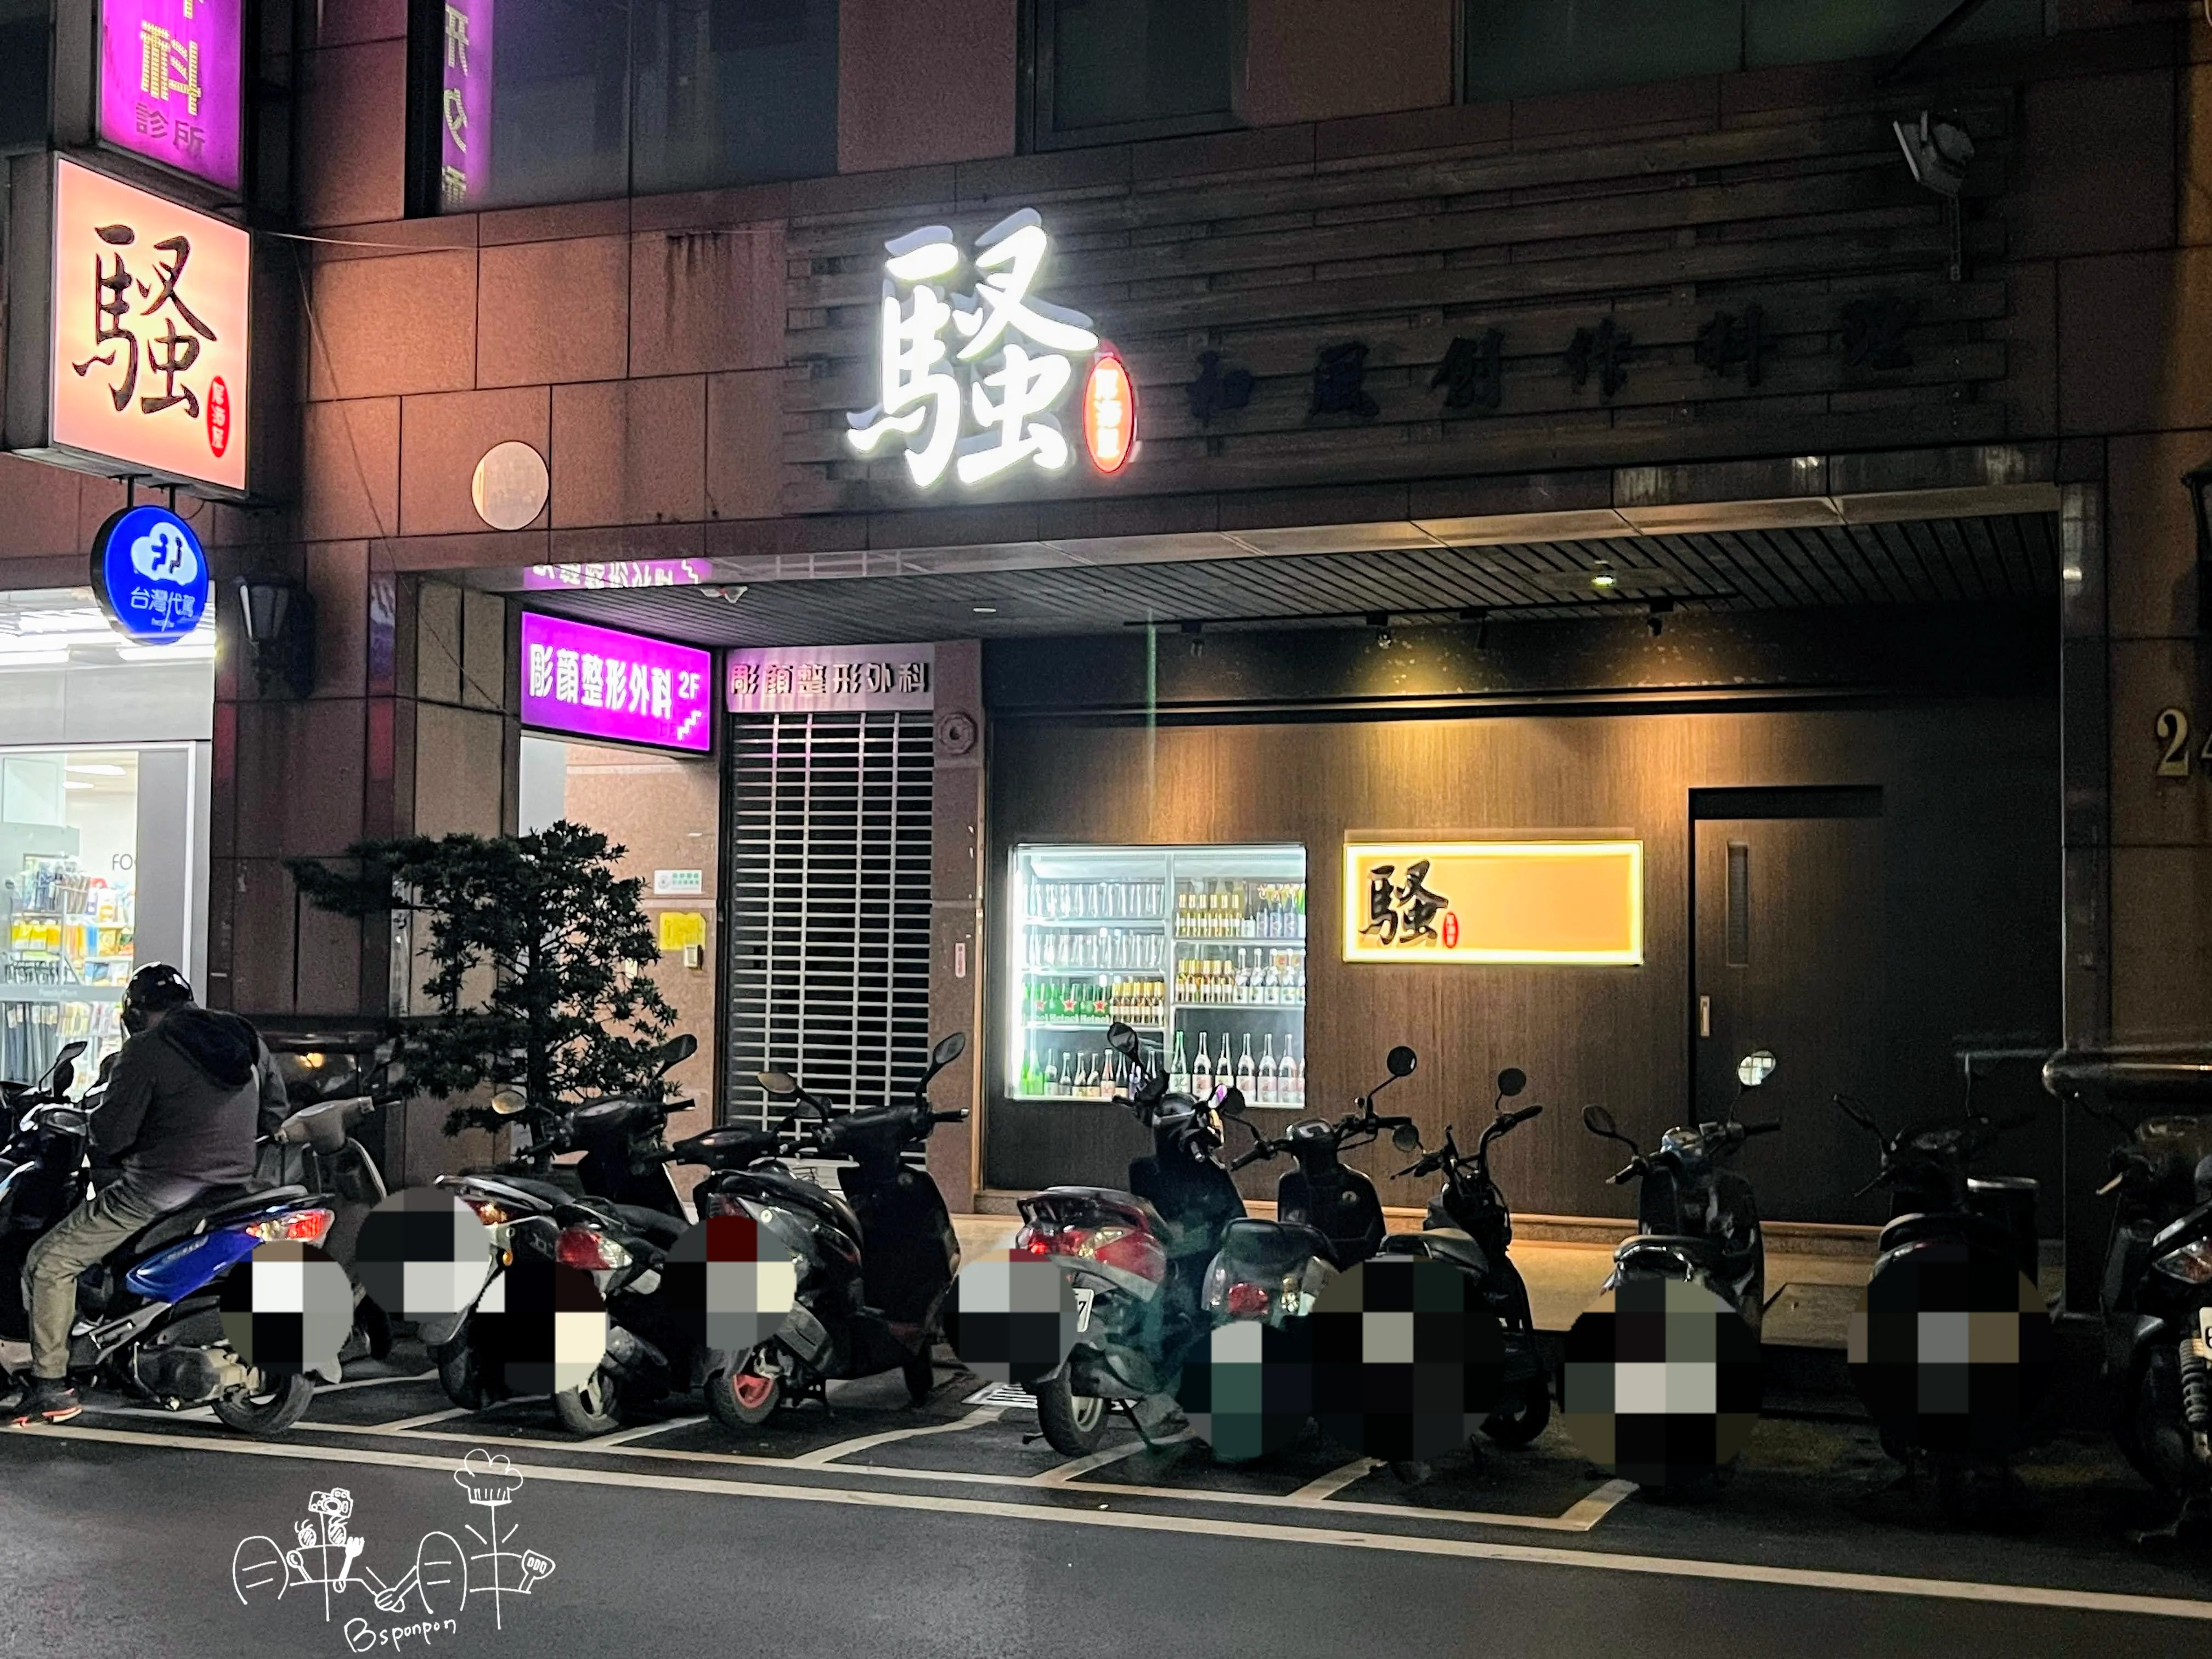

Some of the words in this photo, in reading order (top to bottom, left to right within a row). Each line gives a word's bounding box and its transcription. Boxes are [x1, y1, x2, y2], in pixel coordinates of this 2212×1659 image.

[140, 0, 204, 116] 科
[136, 102, 206, 160] 診所
[678, 670, 701, 700] 2F
[112, 853, 137, 871] FO
